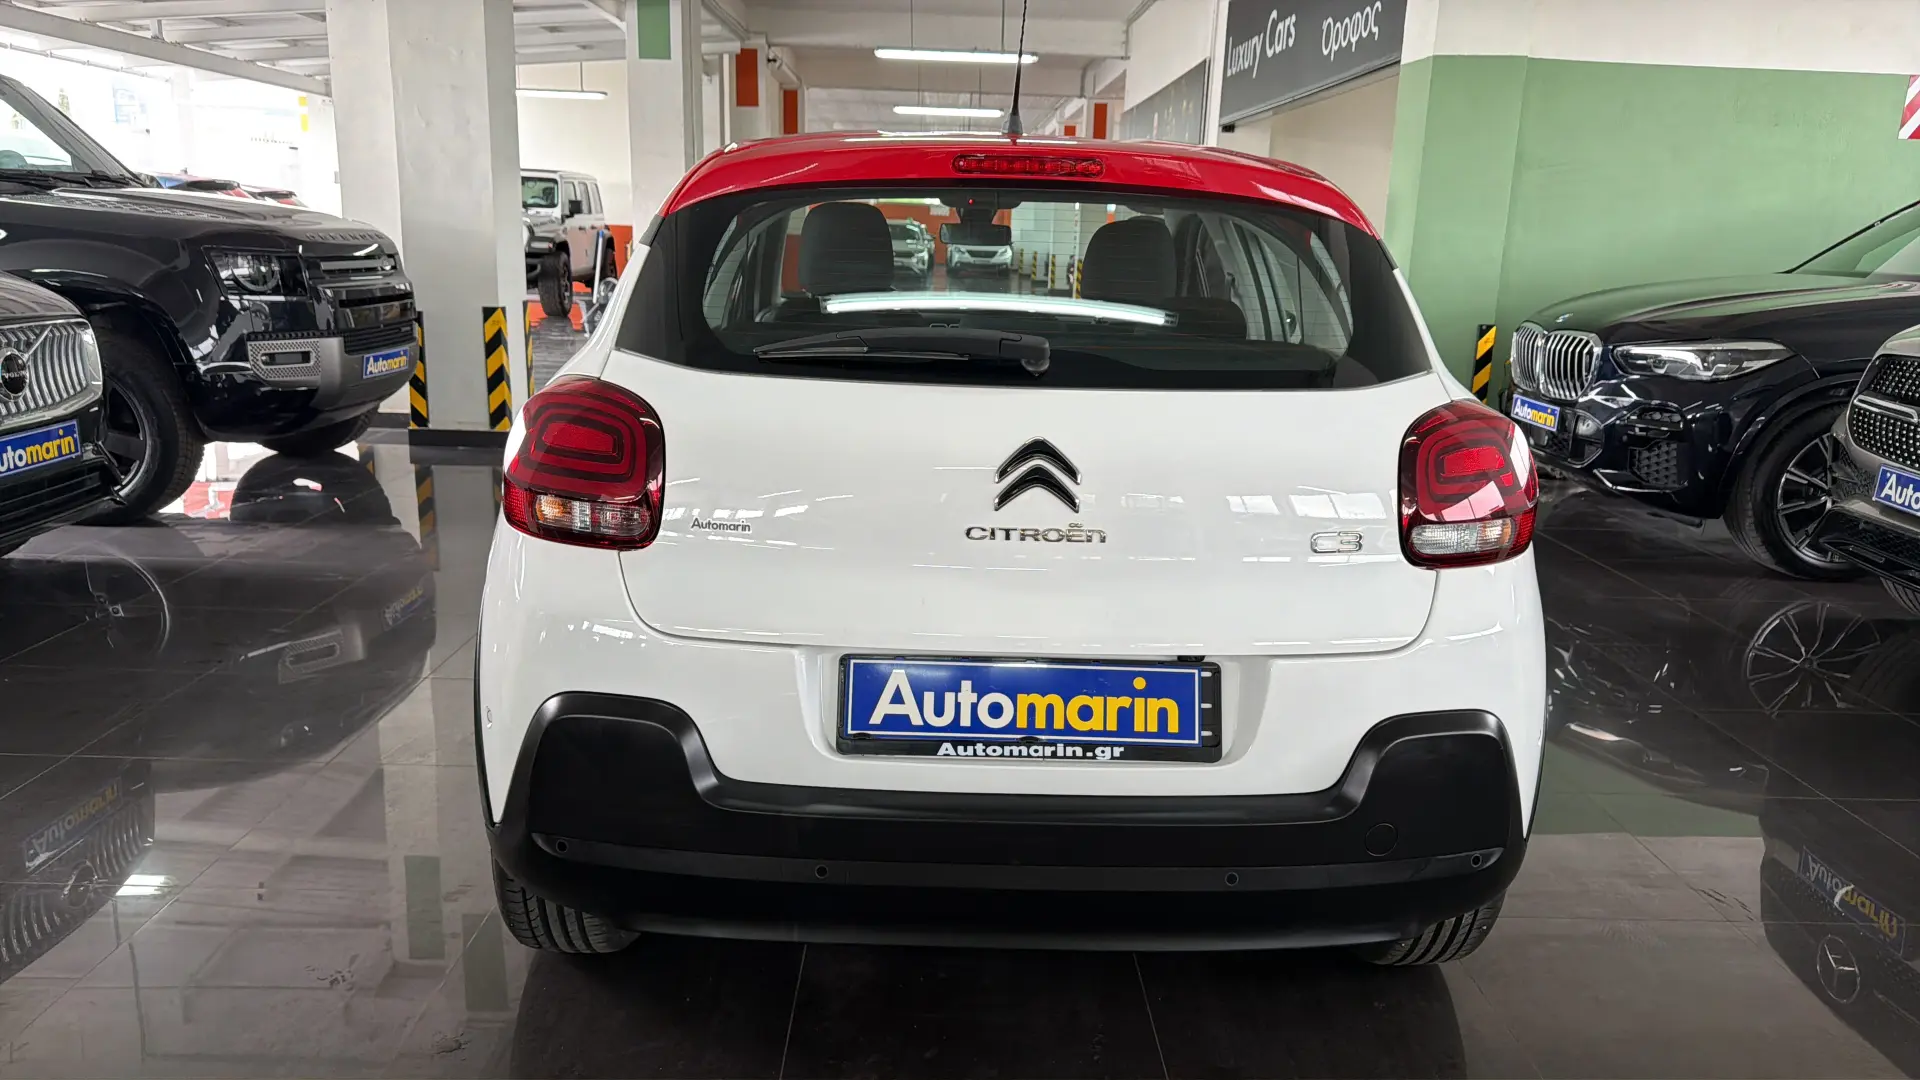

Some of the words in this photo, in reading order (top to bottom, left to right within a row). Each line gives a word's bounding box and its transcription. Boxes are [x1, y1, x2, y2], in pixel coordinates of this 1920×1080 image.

[1227, 32, 1264, 79] Luxury
[1266, 9, 1297, 58] Cars
[1321, 1, 1382, 62] Όροφος
[366, 350, 407, 375] Automarin
[1513, 398, 1555, 428] Automarin
[691, 517, 751, 532] Automarin
[1310, 531, 1363, 553] C3
[868, 669, 1179, 733] Automarin
[937, 742, 1125, 760] Automarin.gr
